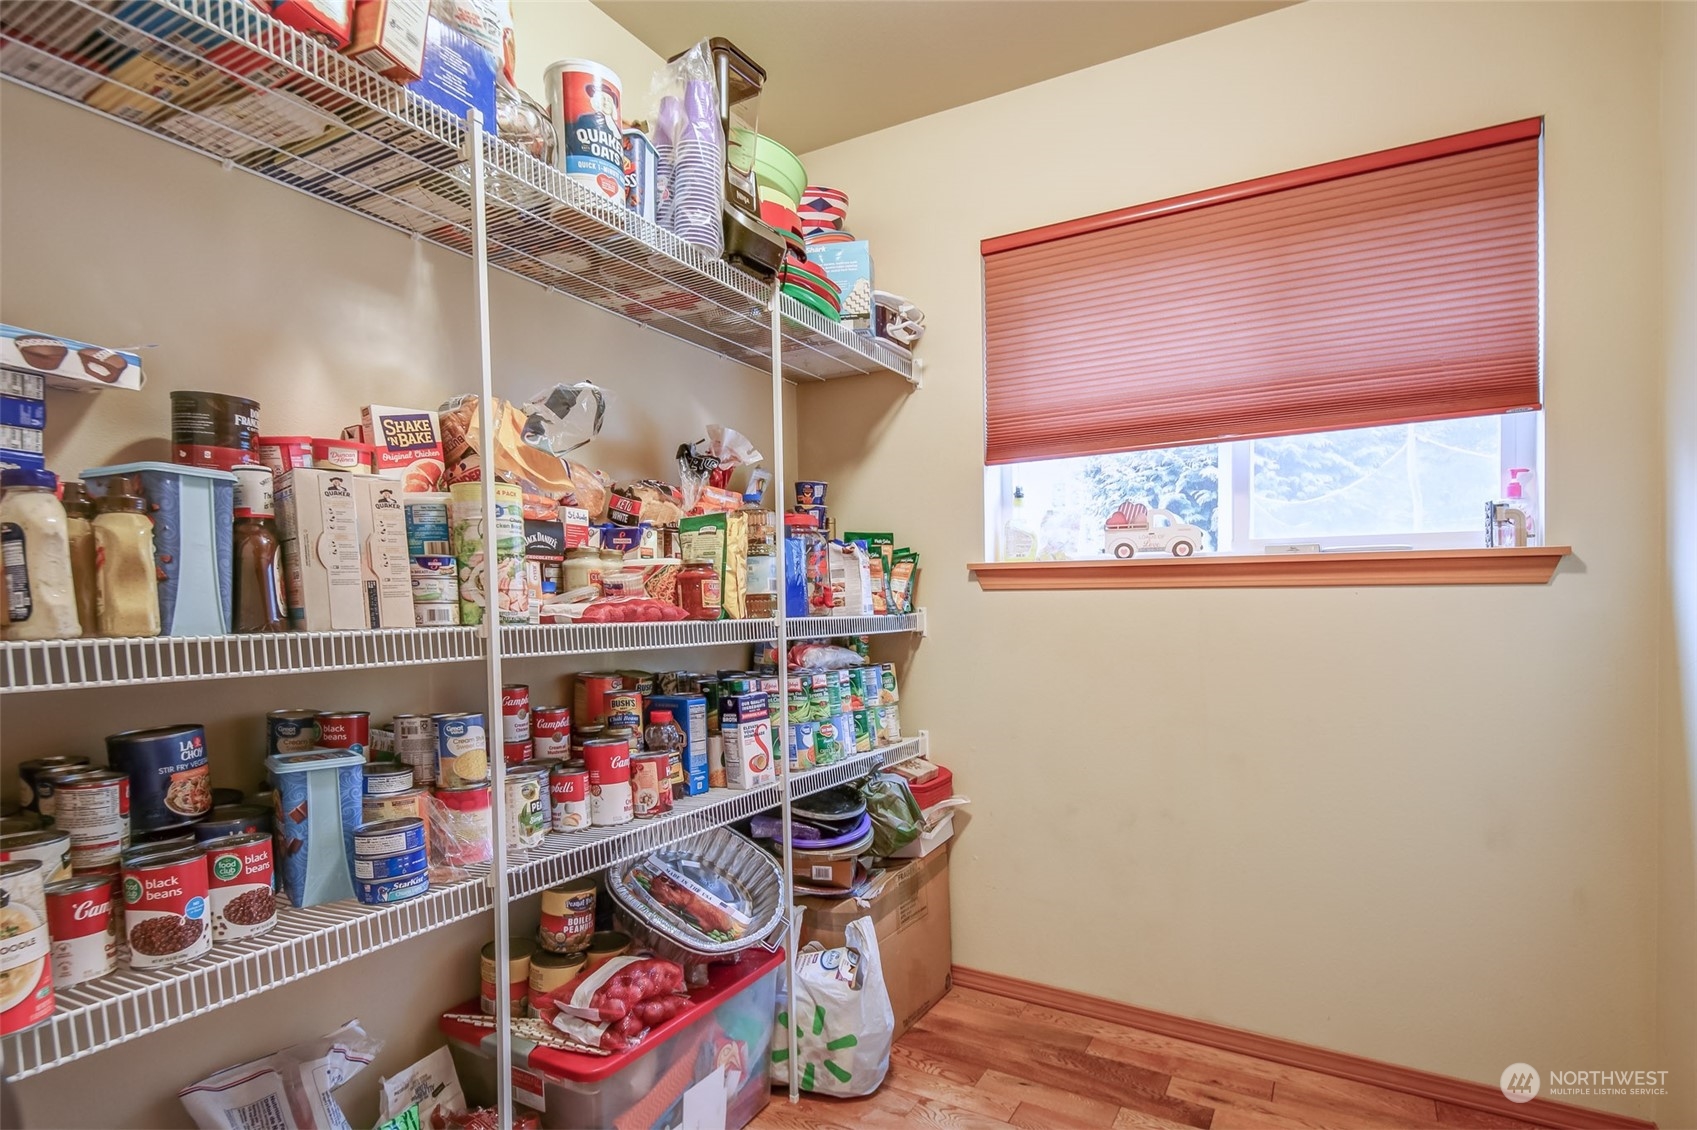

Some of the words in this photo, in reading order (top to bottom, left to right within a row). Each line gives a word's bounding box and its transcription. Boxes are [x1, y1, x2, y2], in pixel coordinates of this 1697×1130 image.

[576, 128, 624, 156] QUAKE
[591, 143, 621, 166] OATS
[577, 160, 596, 170] QUICK
[383, 418, 431, 436] SHAKE
[397, 431, 434, 448] BAKE
[330, 450, 356, 459] Duncan
[382, 452, 413, 463] Original
[414, 450, 440, 458] Chicken
[324, 490, 351, 498] QUAKER
[501, 490, 517, 498] PACK
[375, 502, 401, 510] QUAKER
[616, 499, 634, 513] KETO
[612, 511, 630, 524] WHITE
[525, 534, 537, 546] JACK
[537, 531, 558, 549] DANIEL'S
[611, 699, 636, 708] BUSH'S
[323, 733, 347, 741] beans
[180, 741, 194, 752] LA
[181, 747, 204, 761] CHOY
[158, 767, 174, 775] STIR
[176, 763, 190, 772] FRY
[245, 850, 269, 865] black
[218, 860, 236, 869] food
[245, 862, 271, 875] beans
[219, 867, 236, 876] club
[145, 875, 179, 890] black
[393, 876, 425, 890] StarKist
[665, 868, 681, 880] MADE
[689, 883, 701, 893] THE
[701, 892, 713, 901] USA
[145, 888, 183, 901] beans
[563, 920, 594, 933] PEANUTS
[2, 936, 37, 956] OODLE
[263, 1098, 272, 1114] Datos
[270, 1095, 283, 1123] Nutrition
